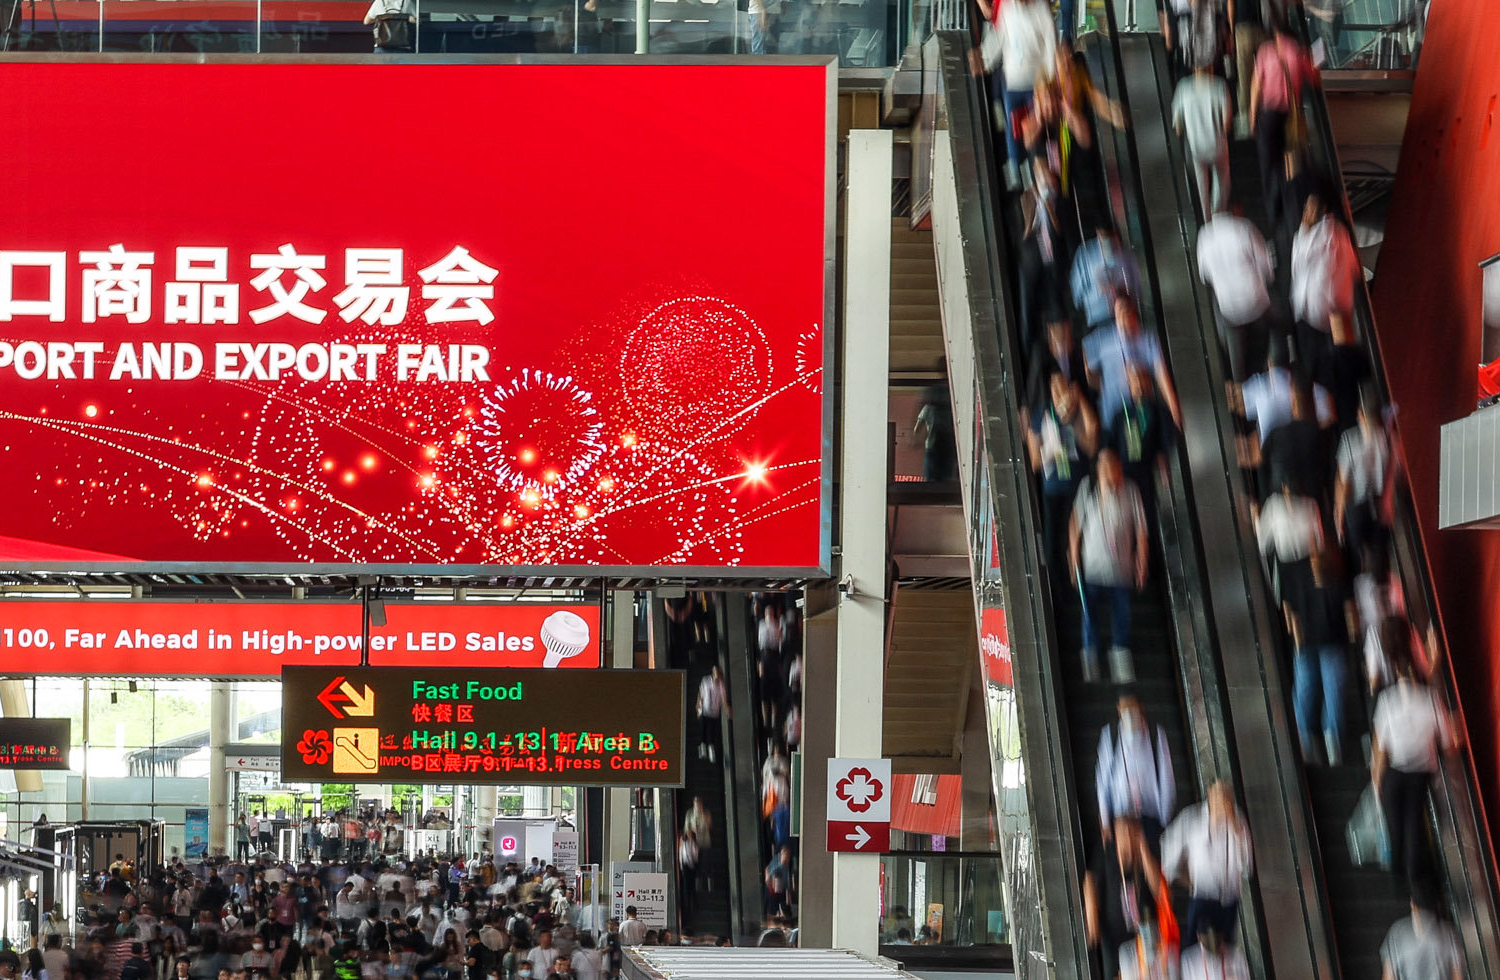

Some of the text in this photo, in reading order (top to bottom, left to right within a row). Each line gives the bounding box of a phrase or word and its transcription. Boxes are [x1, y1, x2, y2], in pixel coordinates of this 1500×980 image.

[113, 341, 203, 383] AND
[214, 342, 386, 385] EXPORT
[396, 343, 491, 385] FAIR
[65, 628, 106, 649] Far
[114, 628, 198, 650] Ahead
[208, 628, 232, 650] in
[241, 630, 397, 655] High-power
[406, 632, 456, 652] LED
[465, 632, 535, 653] Sales
[412, 680, 523, 701] Fast Food
[412, 703, 474, 723] 快餐区
[412, 730, 456, 749] Hall
[576, 732, 630, 751] Area
[638, 732, 655, 751] B
[610, 756, 668, 771] Centre
